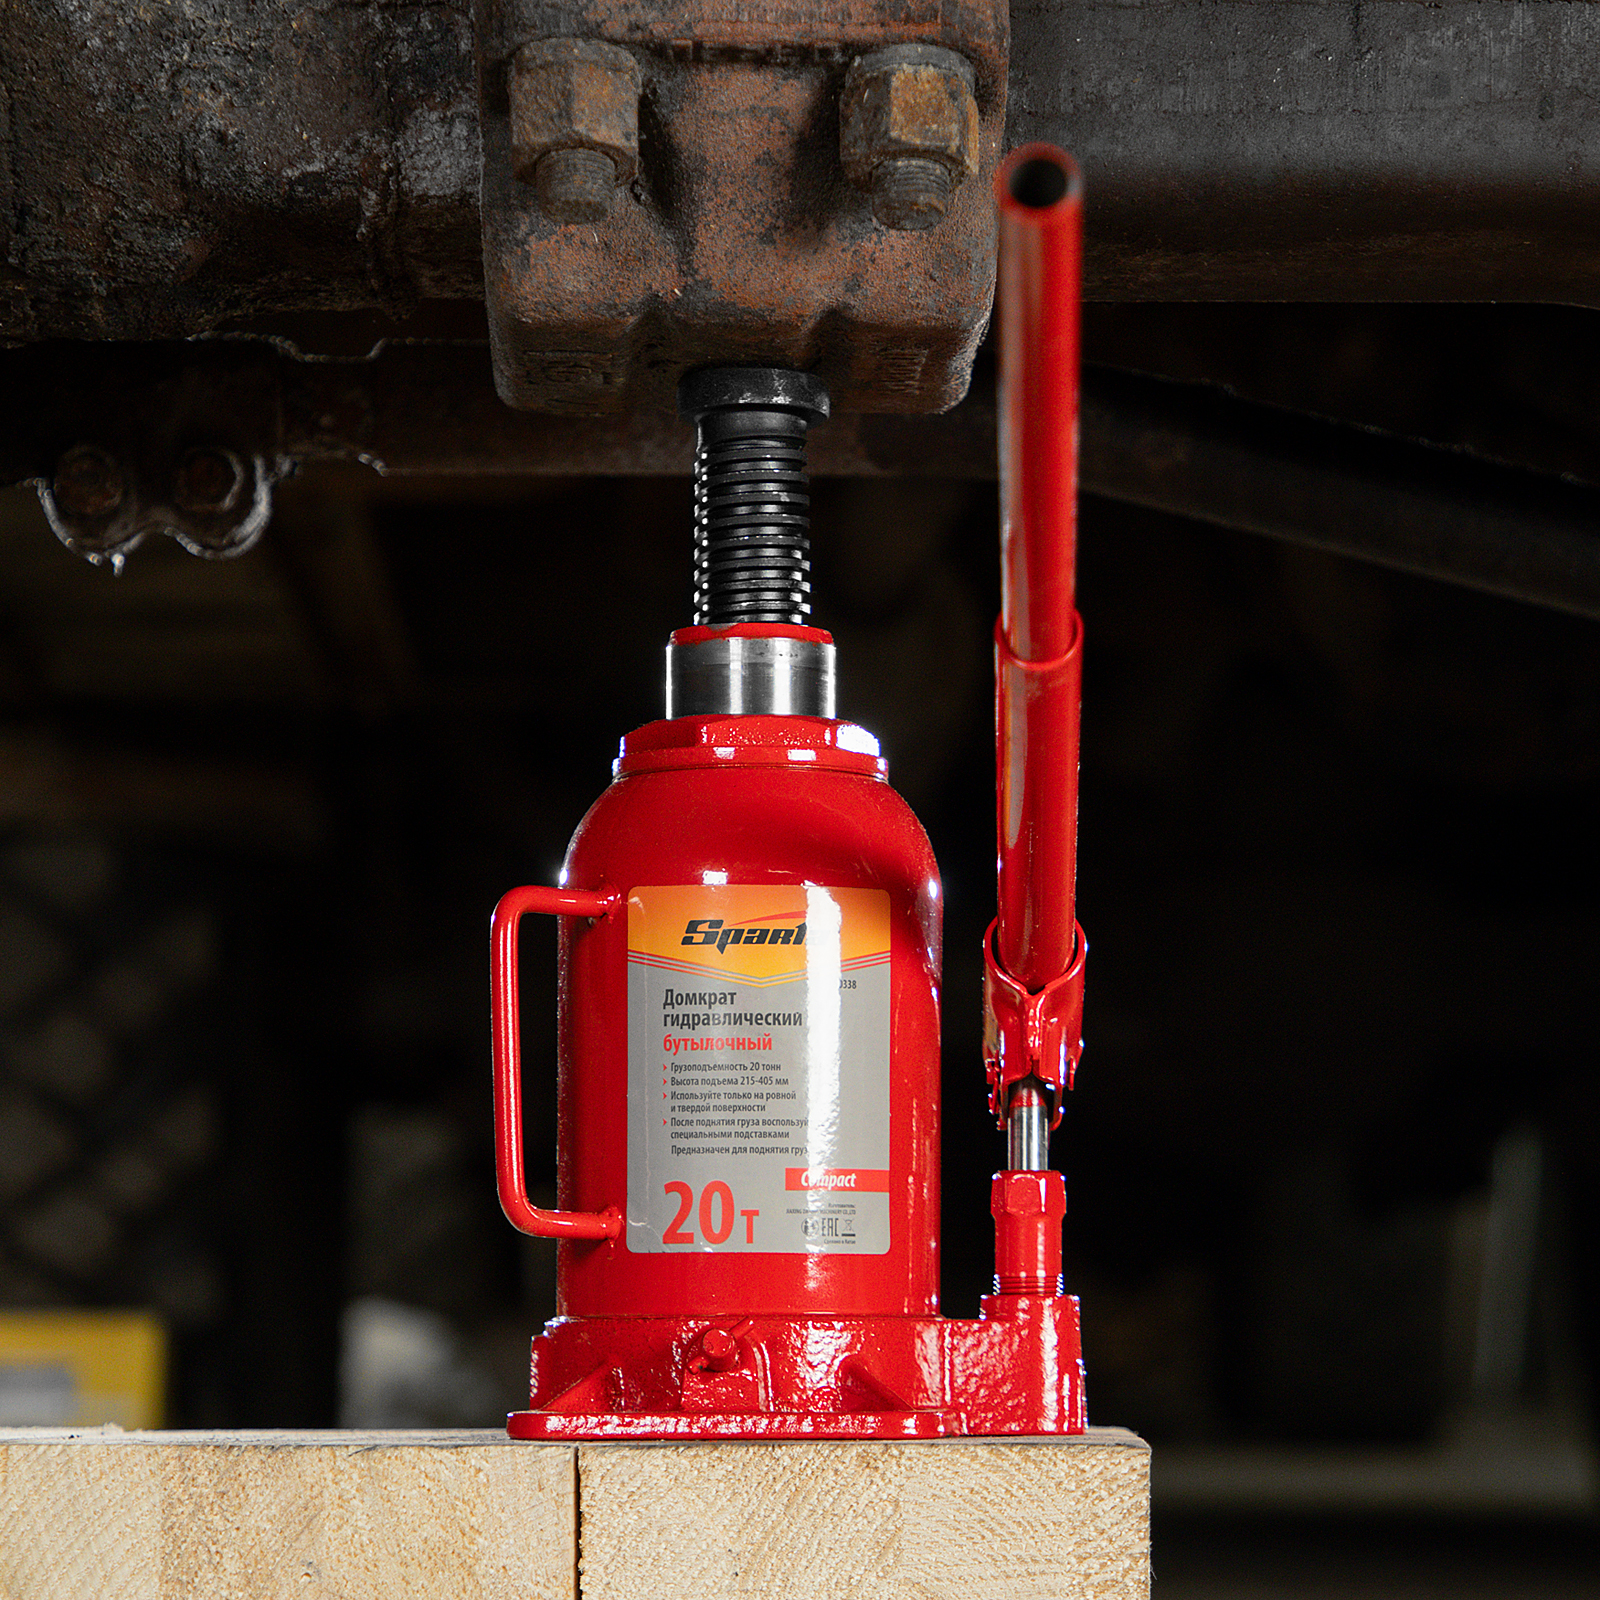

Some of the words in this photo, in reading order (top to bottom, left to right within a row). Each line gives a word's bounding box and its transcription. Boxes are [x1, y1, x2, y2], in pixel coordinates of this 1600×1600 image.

[681, 919, 807, 954] Spart
[663, 988, 737, 1009] Домкрат
[663, 1012, 802, 1031] гидравлический
[663, 1033, 772, 1056] бутылочный
[671, 1062, 748, 1073] Грузоподъемность
[750, 1062, 760, 1071] 20
[762, 1063, 781, 1071] тонн
[671, 1076, 699, 1086] Высота
[701, 1077, 738, 1087] подъема
[740, 1076, 773, 1085] 215-405
[775, 1078, 789, 1086] мм
[671, 1091, 721, 1101] Используйте
[723, 1092, 752, 1100] только
[754, 1092, 764, 1100] на
[766, 1090, 796, 1101] ровной
[677, 1103, 710, 1113] твердой
[712, 1104, 766, 1113] поверхности
[671, 1117, 694, 1127] После
[696, 1119, 735, 1128] поднятия
[737, 1118, 760, 1127] груза
[762, 1117, 808, 1128] воспользуй
[671, 1130, 732, 1140] специальными
[734, 1130, 789, 1139] подставками
[671, 1145, 729, 1155] Предназначен
[732, 1146, 747, 1155] для
[749, 1146, 789, 1155] поднятия
[791, 1146, 808, 1156] груз
